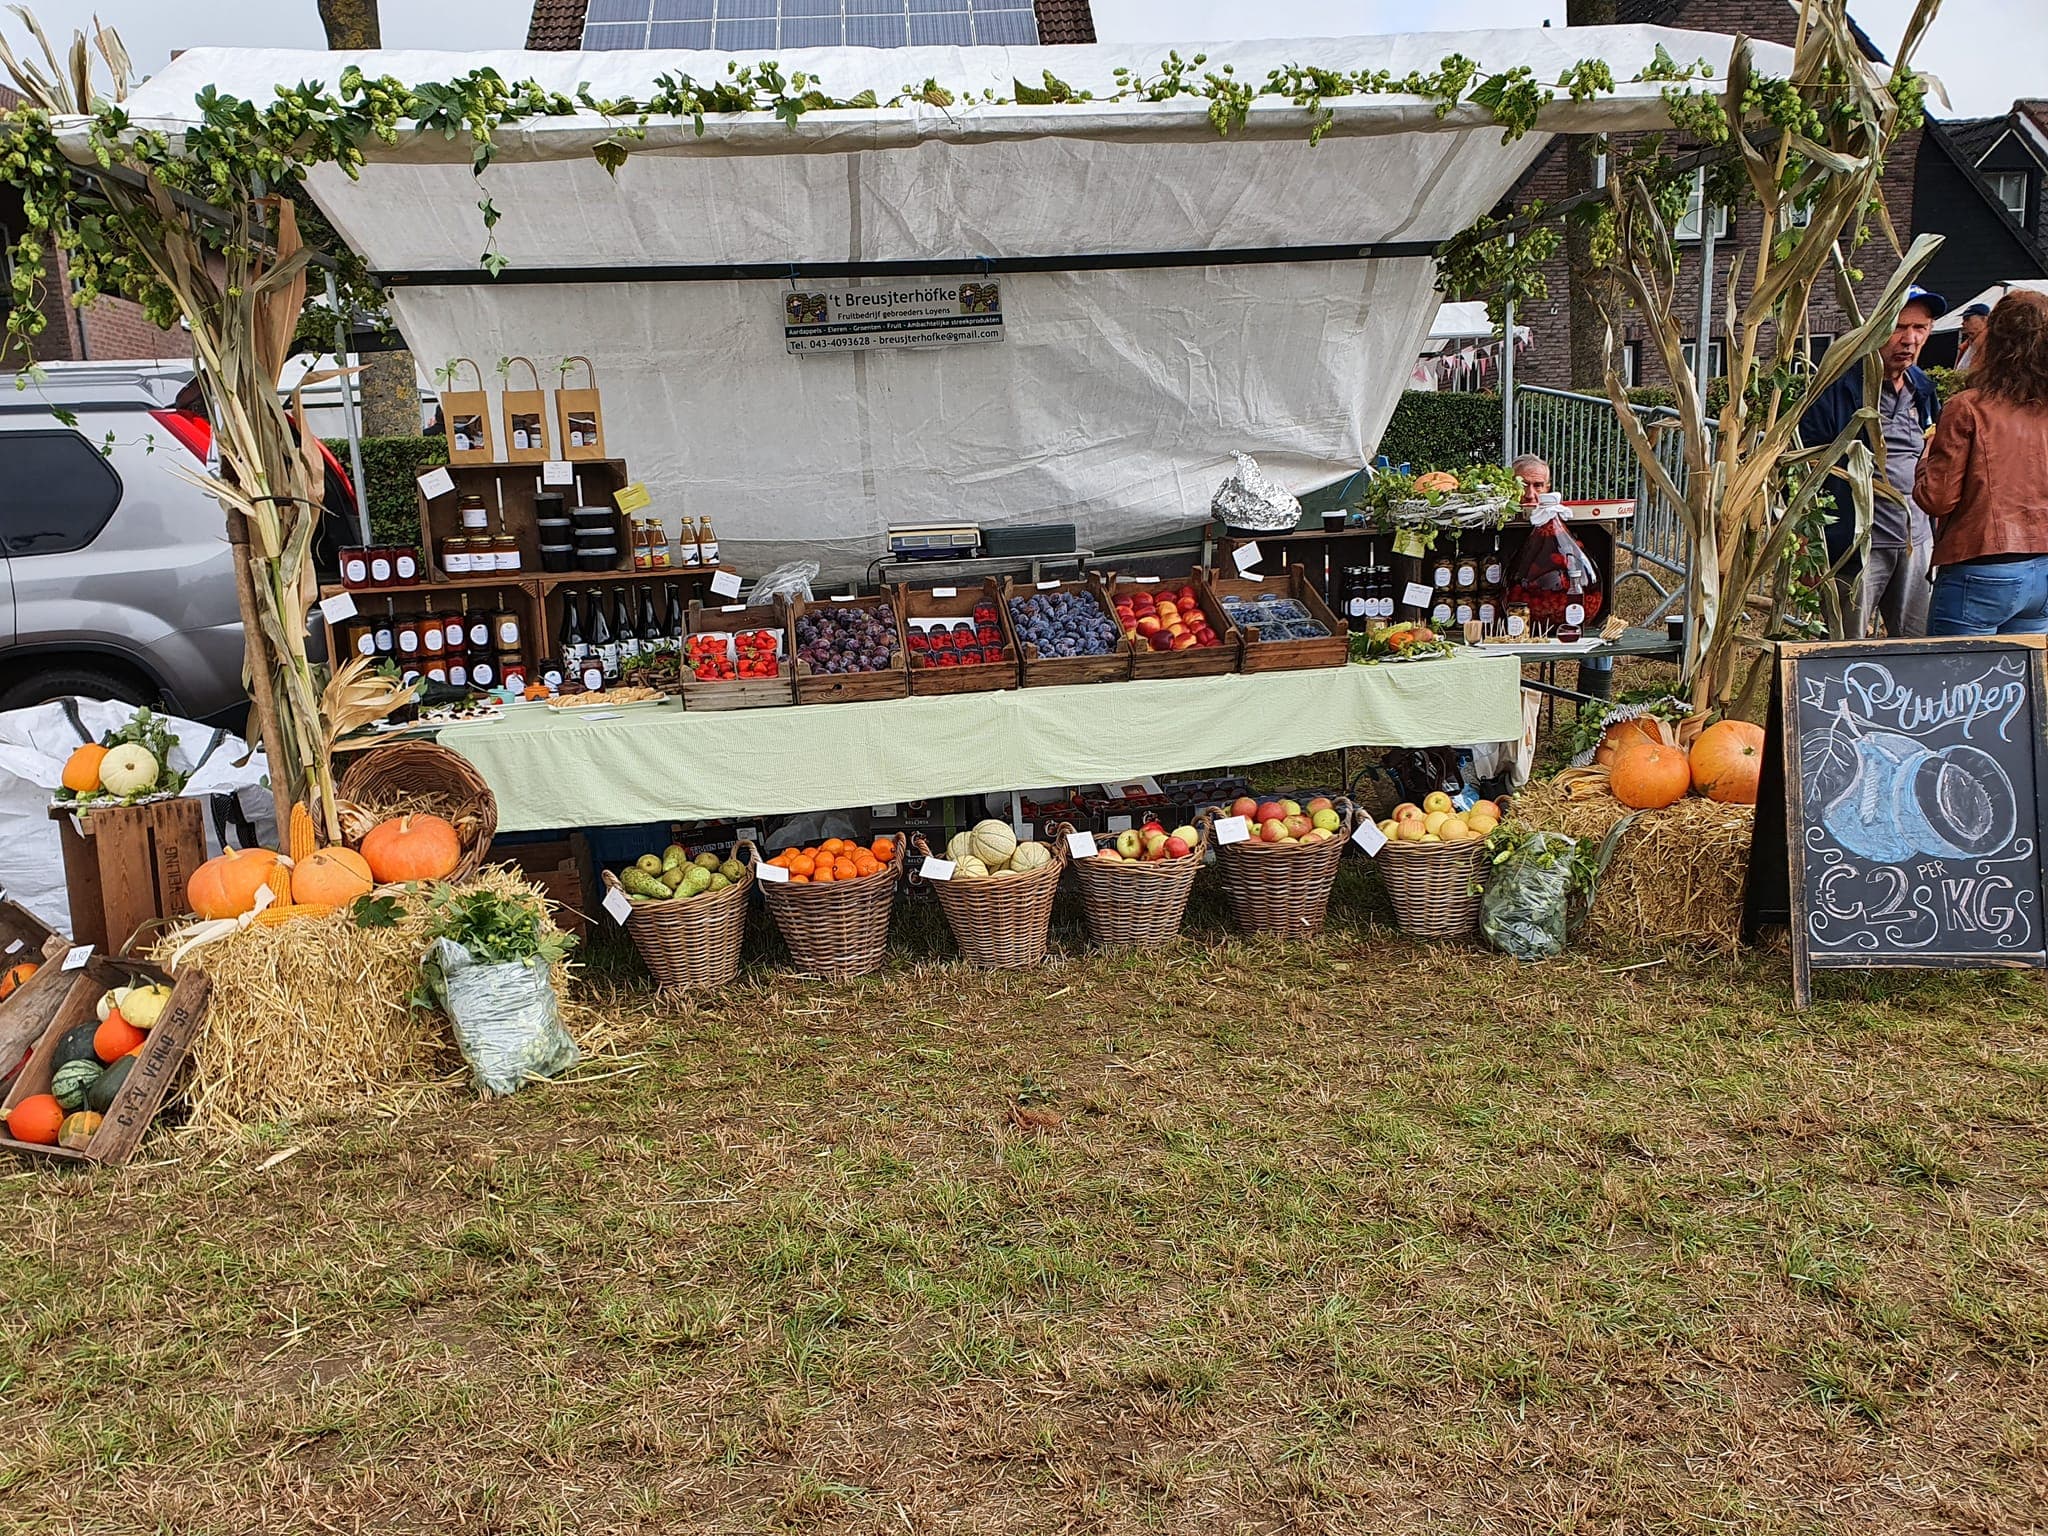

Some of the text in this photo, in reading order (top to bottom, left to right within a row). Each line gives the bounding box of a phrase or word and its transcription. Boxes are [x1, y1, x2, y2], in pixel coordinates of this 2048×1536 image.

[846, 288, 957, 307] Breusjterhöfke
[837, 307, 950, 320] Fruitbedrijf gebroeders Loyens
[790, 341, 806, 349] Tel.
[810, 337, 870, 348] 043-4093628
[879, 330, 999, 345] breusjterhofke@gmail.com
[1844, 662, 2026, 742] Pruimen
[164, 846, 183, 895] VEILING
[1917, 861, 1947, 880] PER
[1941, 876, 2015, 934] KG
[143, 1034, 175, 1078] VENLO
